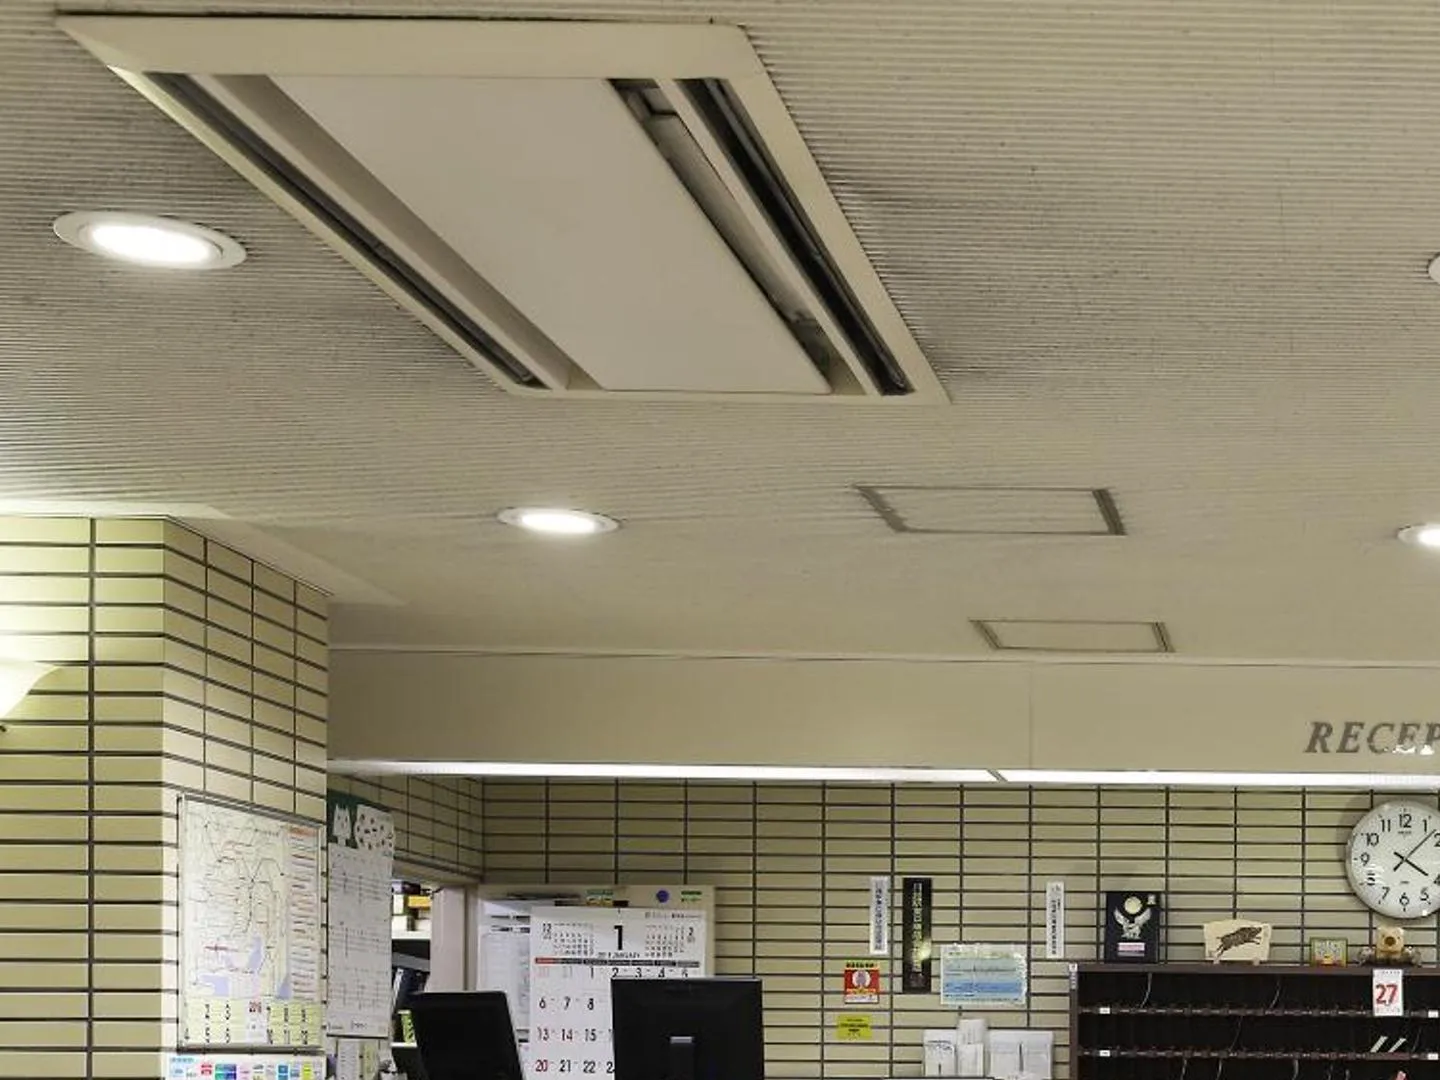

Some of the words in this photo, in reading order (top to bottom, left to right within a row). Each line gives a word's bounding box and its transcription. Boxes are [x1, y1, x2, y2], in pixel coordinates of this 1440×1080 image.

[1381, 819, 1391, 832] 11
[1398, 813, 1412, 828] 12
[1366, 832, 1379, 846] 10
[1360, 852, 1370, 866] 9
[1382, 886, 1391, 900] 7
[1399, 892, 1409, 905] 6
[1420, 887, 1429, 901] 5
[614, 925, 623, 950] 1
[1375, 983, 1398, 1004] 27
[539, 997, 546, 1009] 6
[563, 996, 571, 1009] 7
[587, 998, 594, 1010] 8
[537, 1027, 550, 1041] 13
[561, 1028, 573, 1042] 14
[585, 1028, 597, 1042] 15
[535, 1060, 548, 1072] 20
[559, 1059, 571, 1072] 21
[583, 1061, 596, 1074] 22
